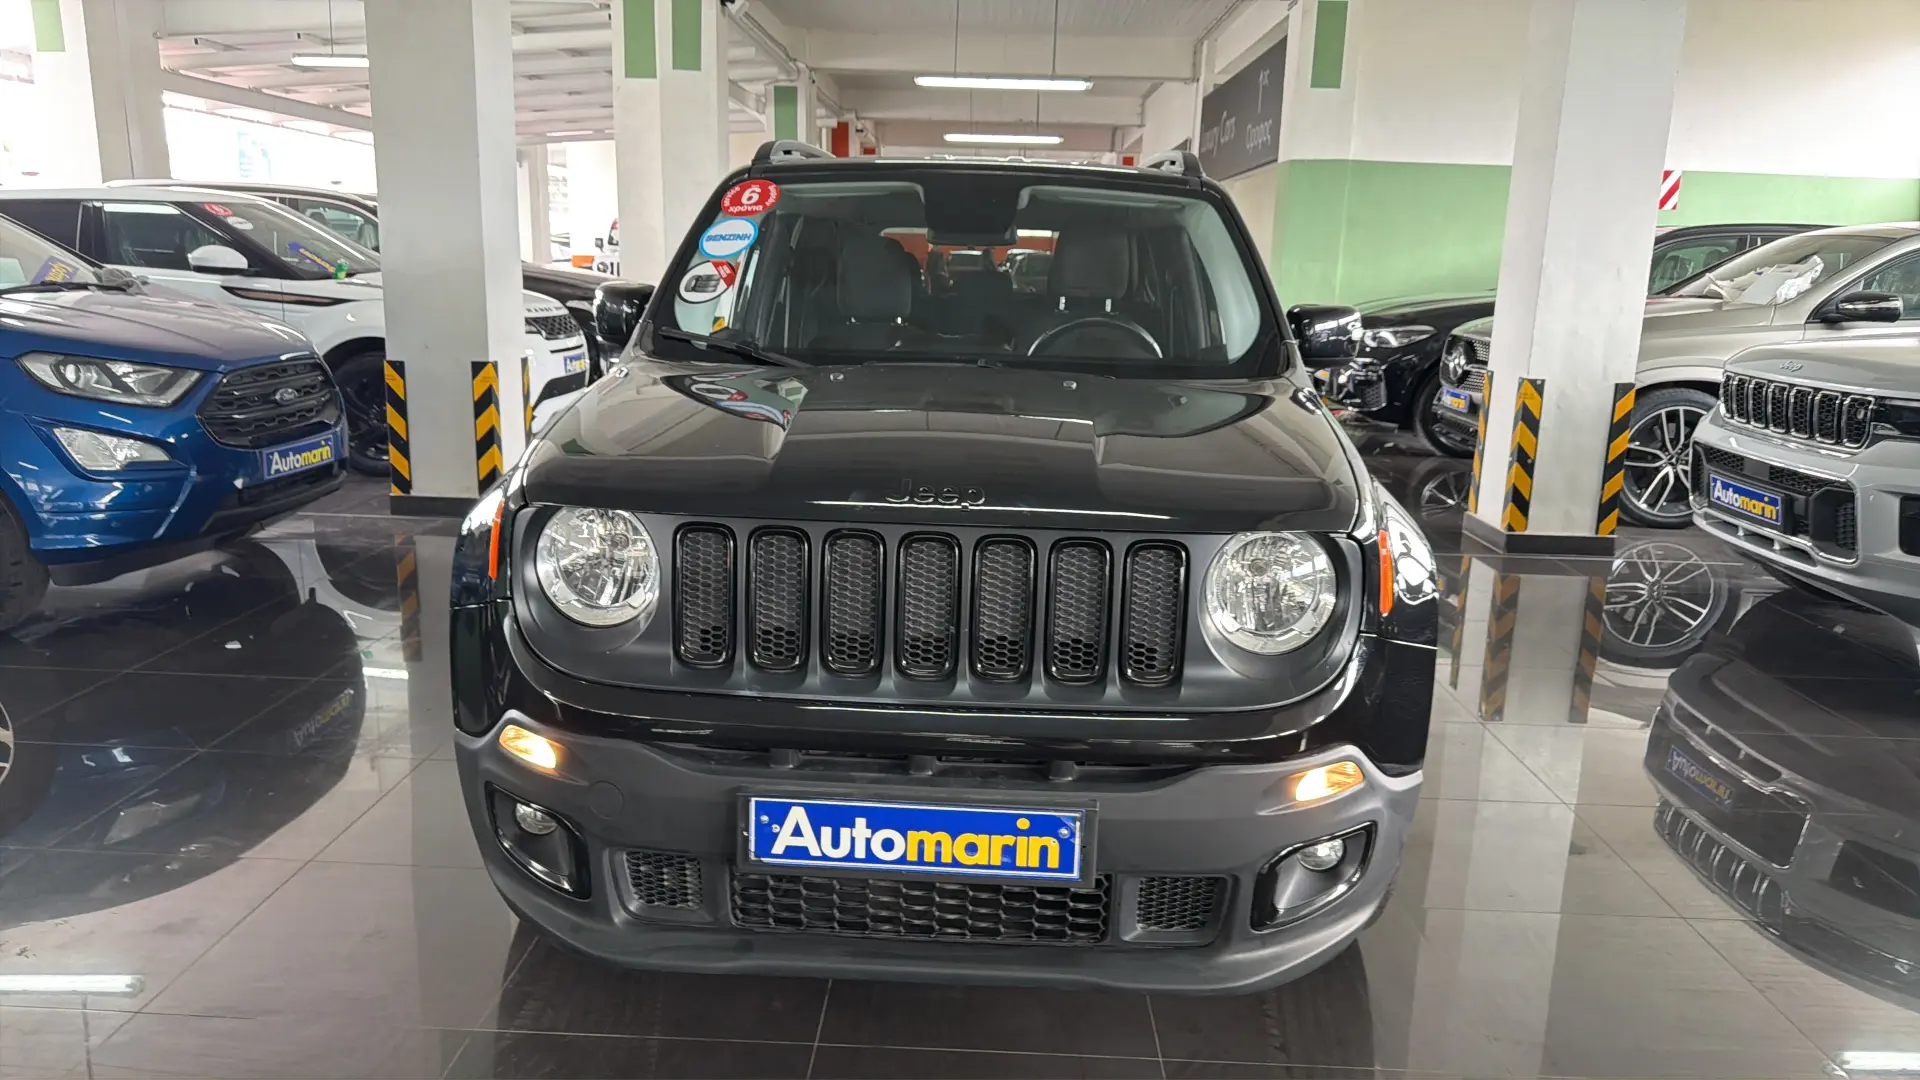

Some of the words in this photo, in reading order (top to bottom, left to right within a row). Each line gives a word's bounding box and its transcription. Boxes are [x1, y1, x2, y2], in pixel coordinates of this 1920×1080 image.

[740, 187, 762, 205] 6
[270, 440, 332, 475] Automarin
[884, 478, 986, 511] Jeep
[1713, 479, 1777, 521] Automarin
[770, 805, 1060, 869] Automarin
